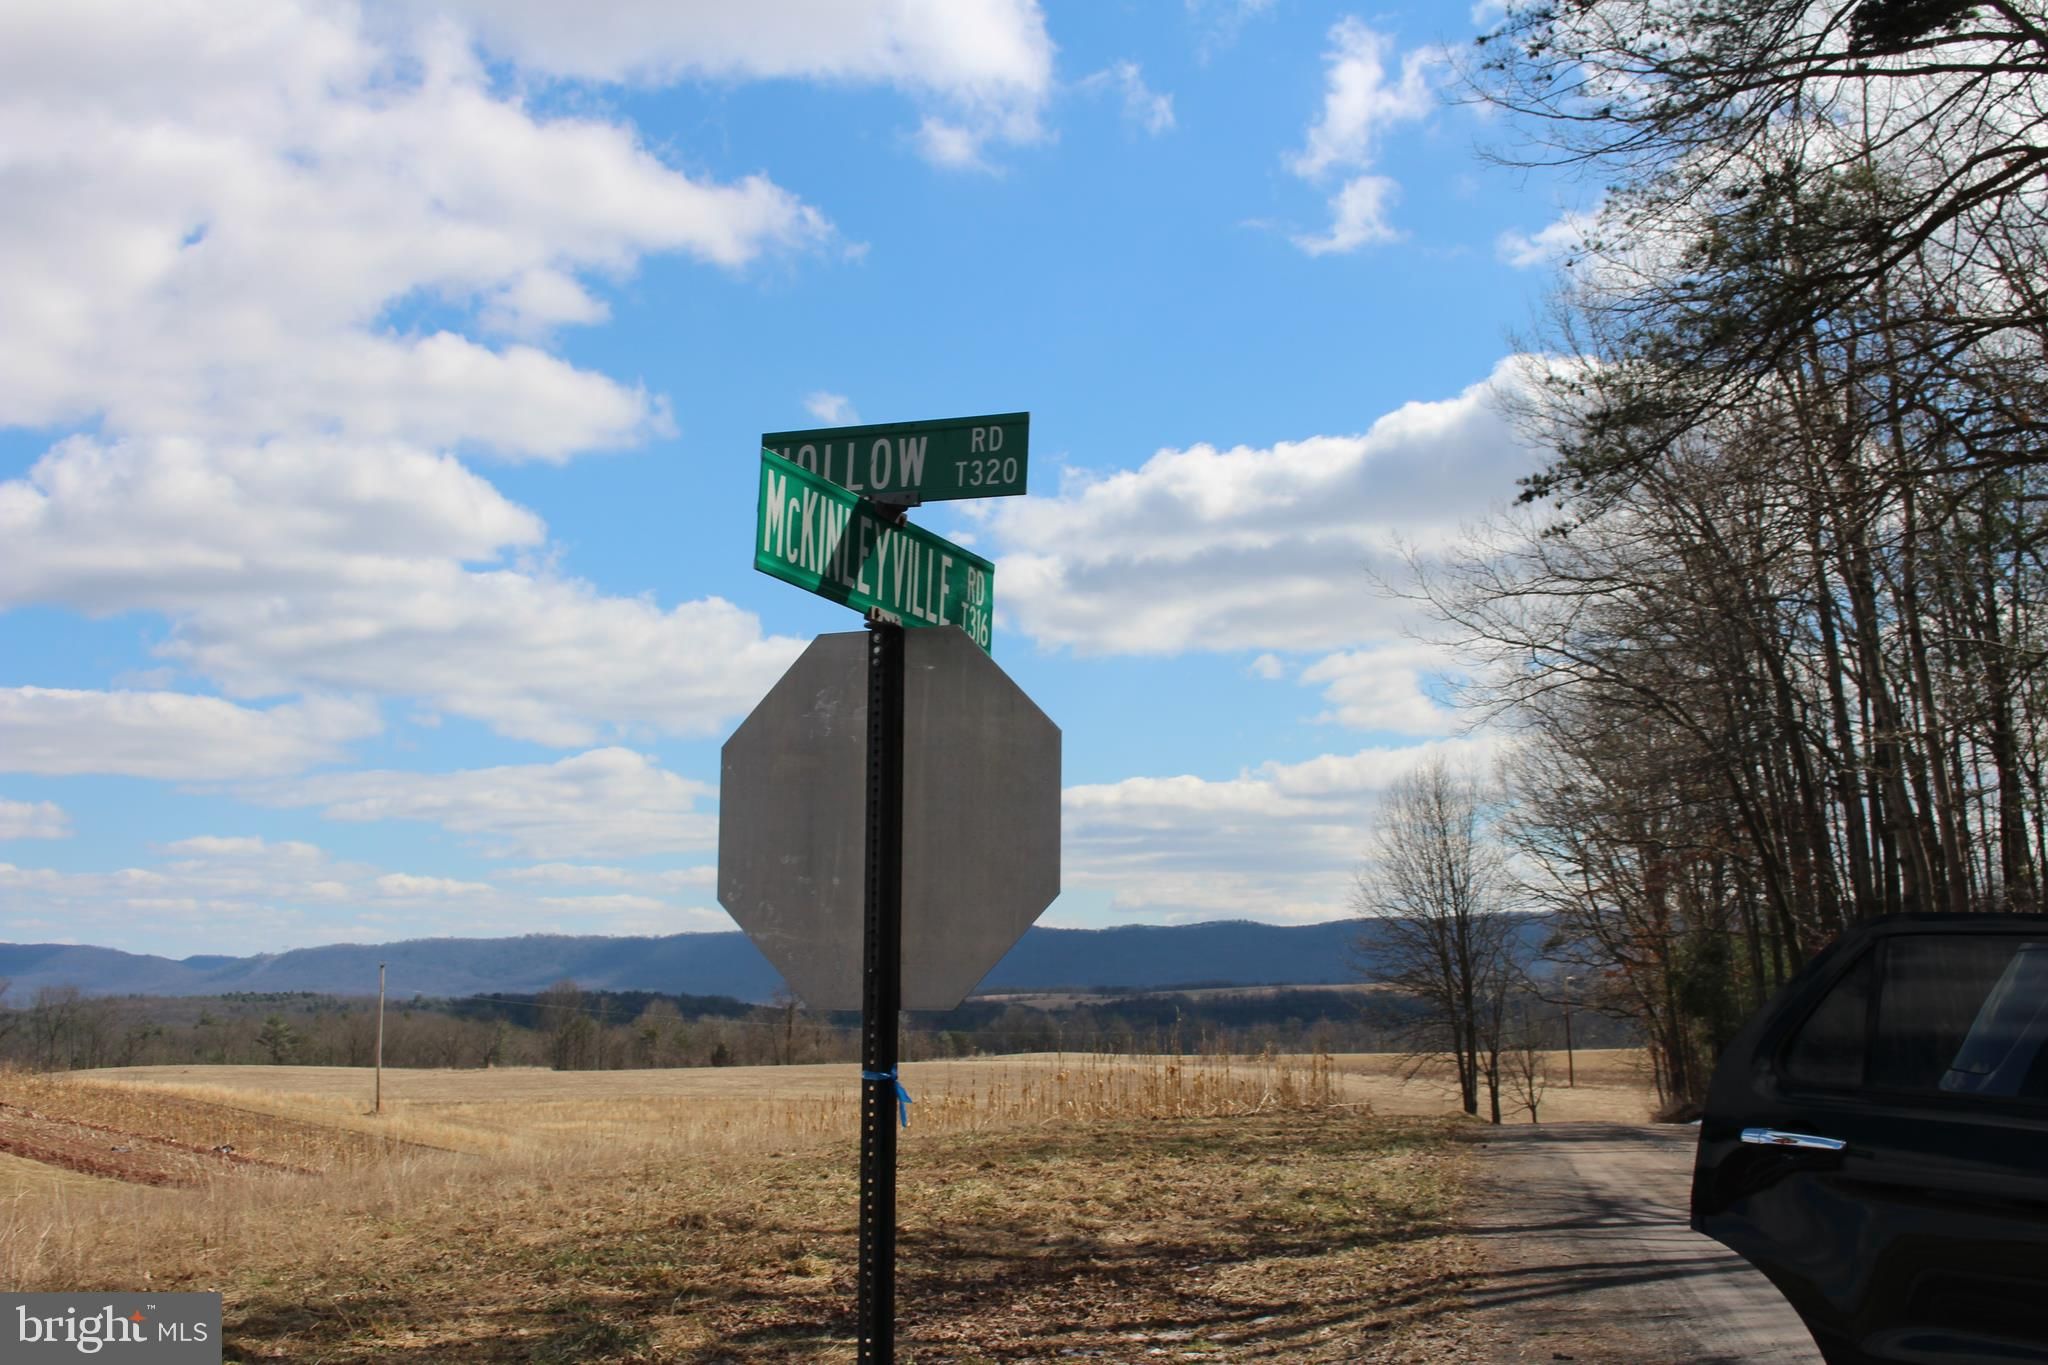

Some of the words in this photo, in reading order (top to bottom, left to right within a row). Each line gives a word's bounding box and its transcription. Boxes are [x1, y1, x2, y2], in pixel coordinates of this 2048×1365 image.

[771, 436, 928, 491] OLLOW
[971, 425, 1004, 453] RD
[955, 457, 1018, 487] T320
[763, 469, 953, 626] McKINLEYVILLE
[967, 565, 985, 606] RD
[961, 601, 989, 648] T316
